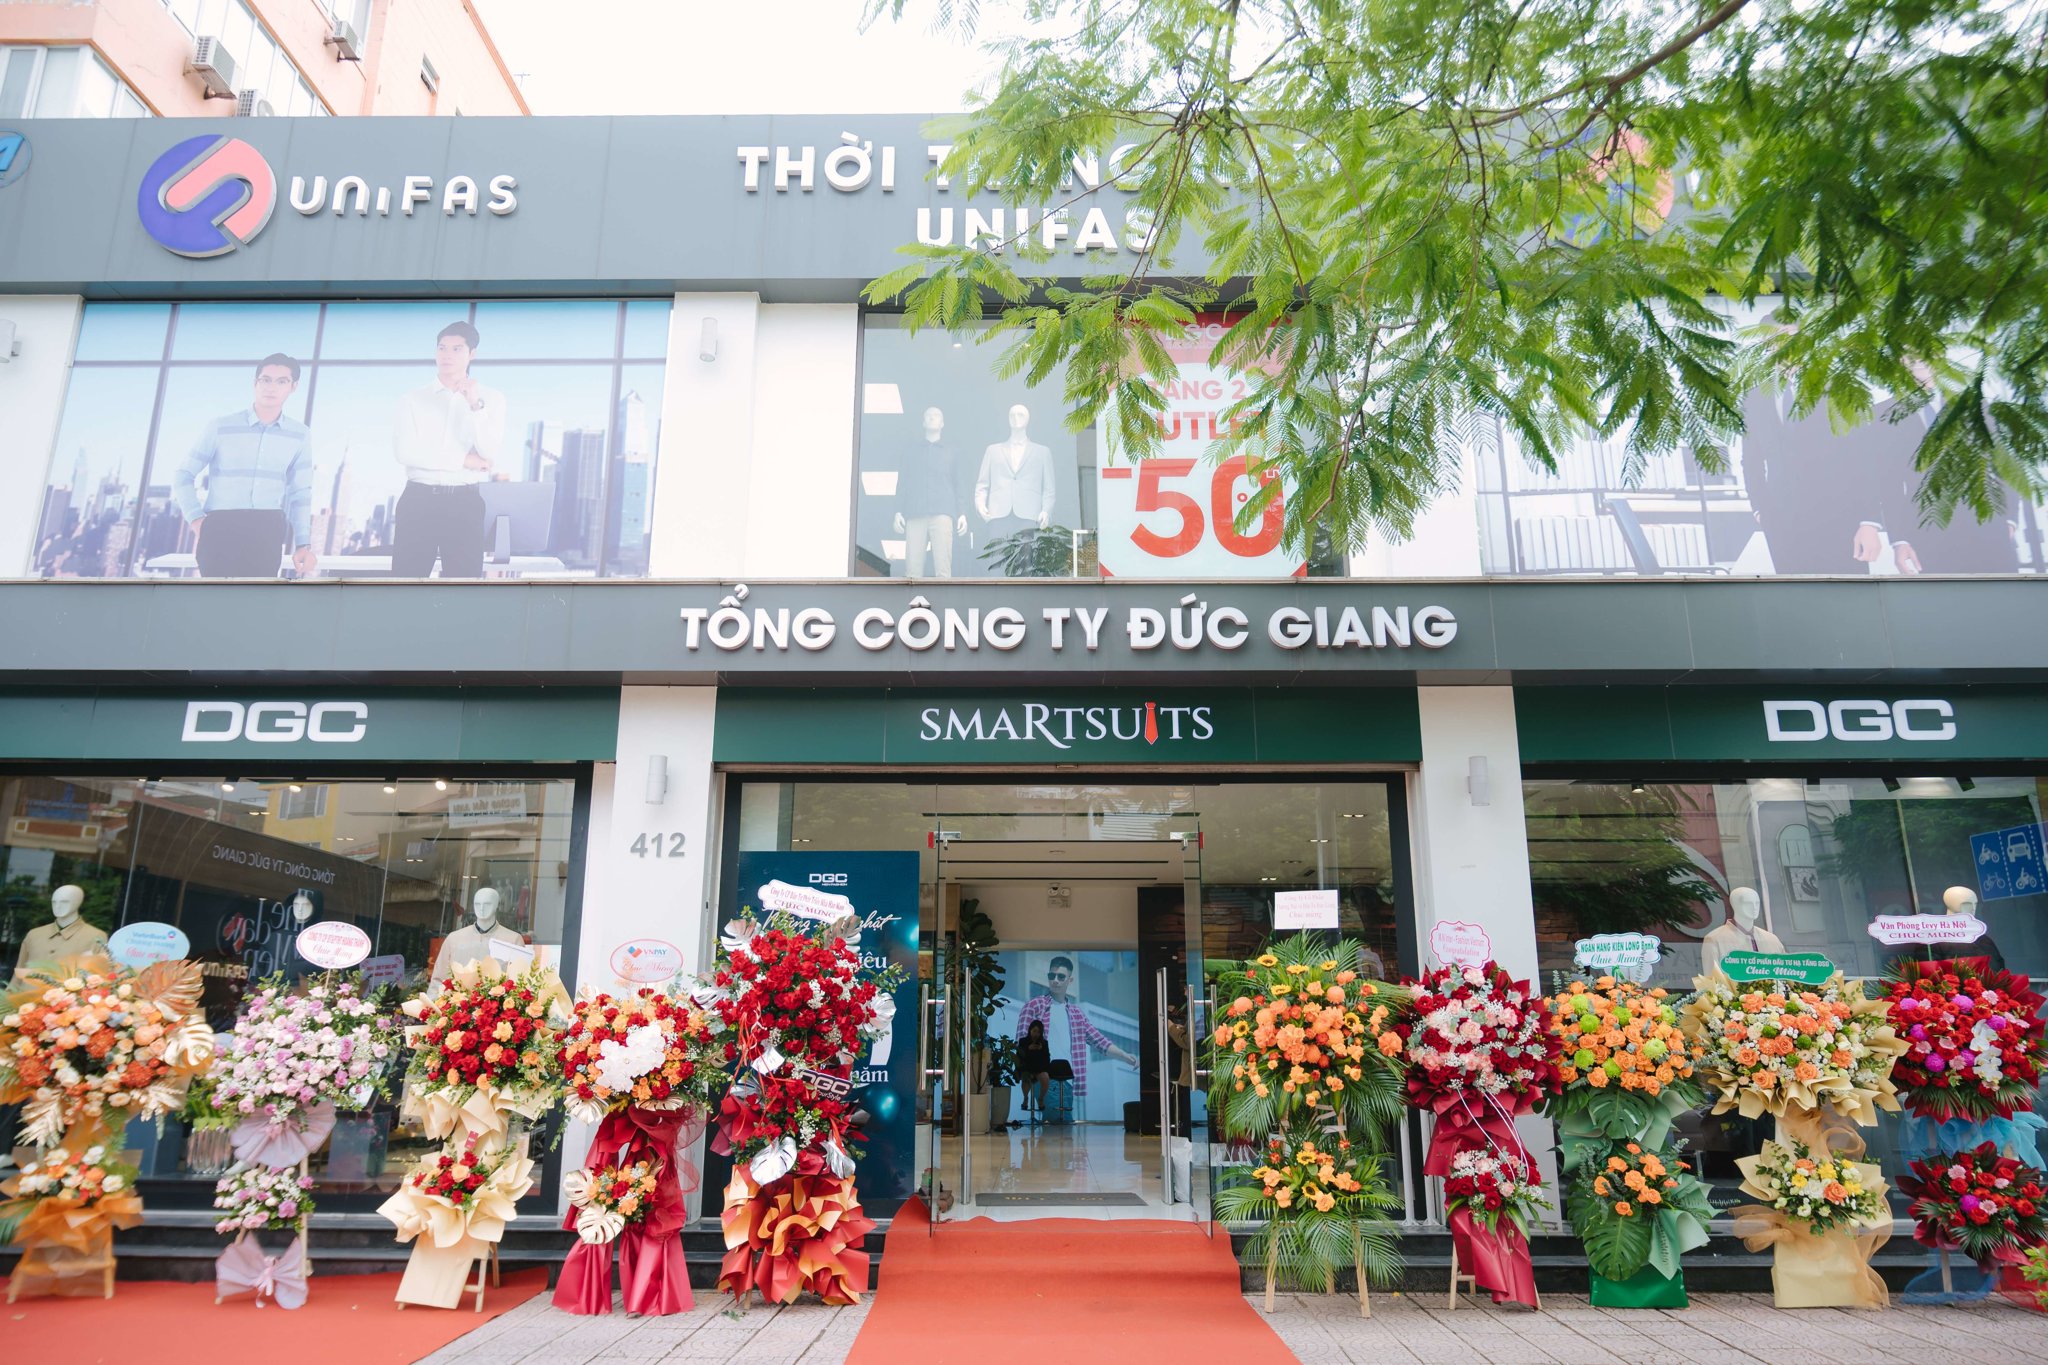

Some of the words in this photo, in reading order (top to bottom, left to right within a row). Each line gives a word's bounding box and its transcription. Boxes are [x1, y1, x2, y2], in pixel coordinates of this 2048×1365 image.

[737, 131, 895, 192] THỜI
[916, 207, 1159, 254] UNIFAS
[680, 583, 837, 651] TỔNG
[852, 595, 1027, 651] CÔNG
[1042, 607, 1109, 650] TY
[1126, 592, 1249, 650] ĐỨC
[1268, 605, 1458, 650] GIANG
[181, 701, 368, 742] DGC
[1763, 699, 1957, 741] DGC
[630, 832, 687, 858] 412
[809, 873, 848, 883] DGC
[1625, 941, 1640, 951] LONG
